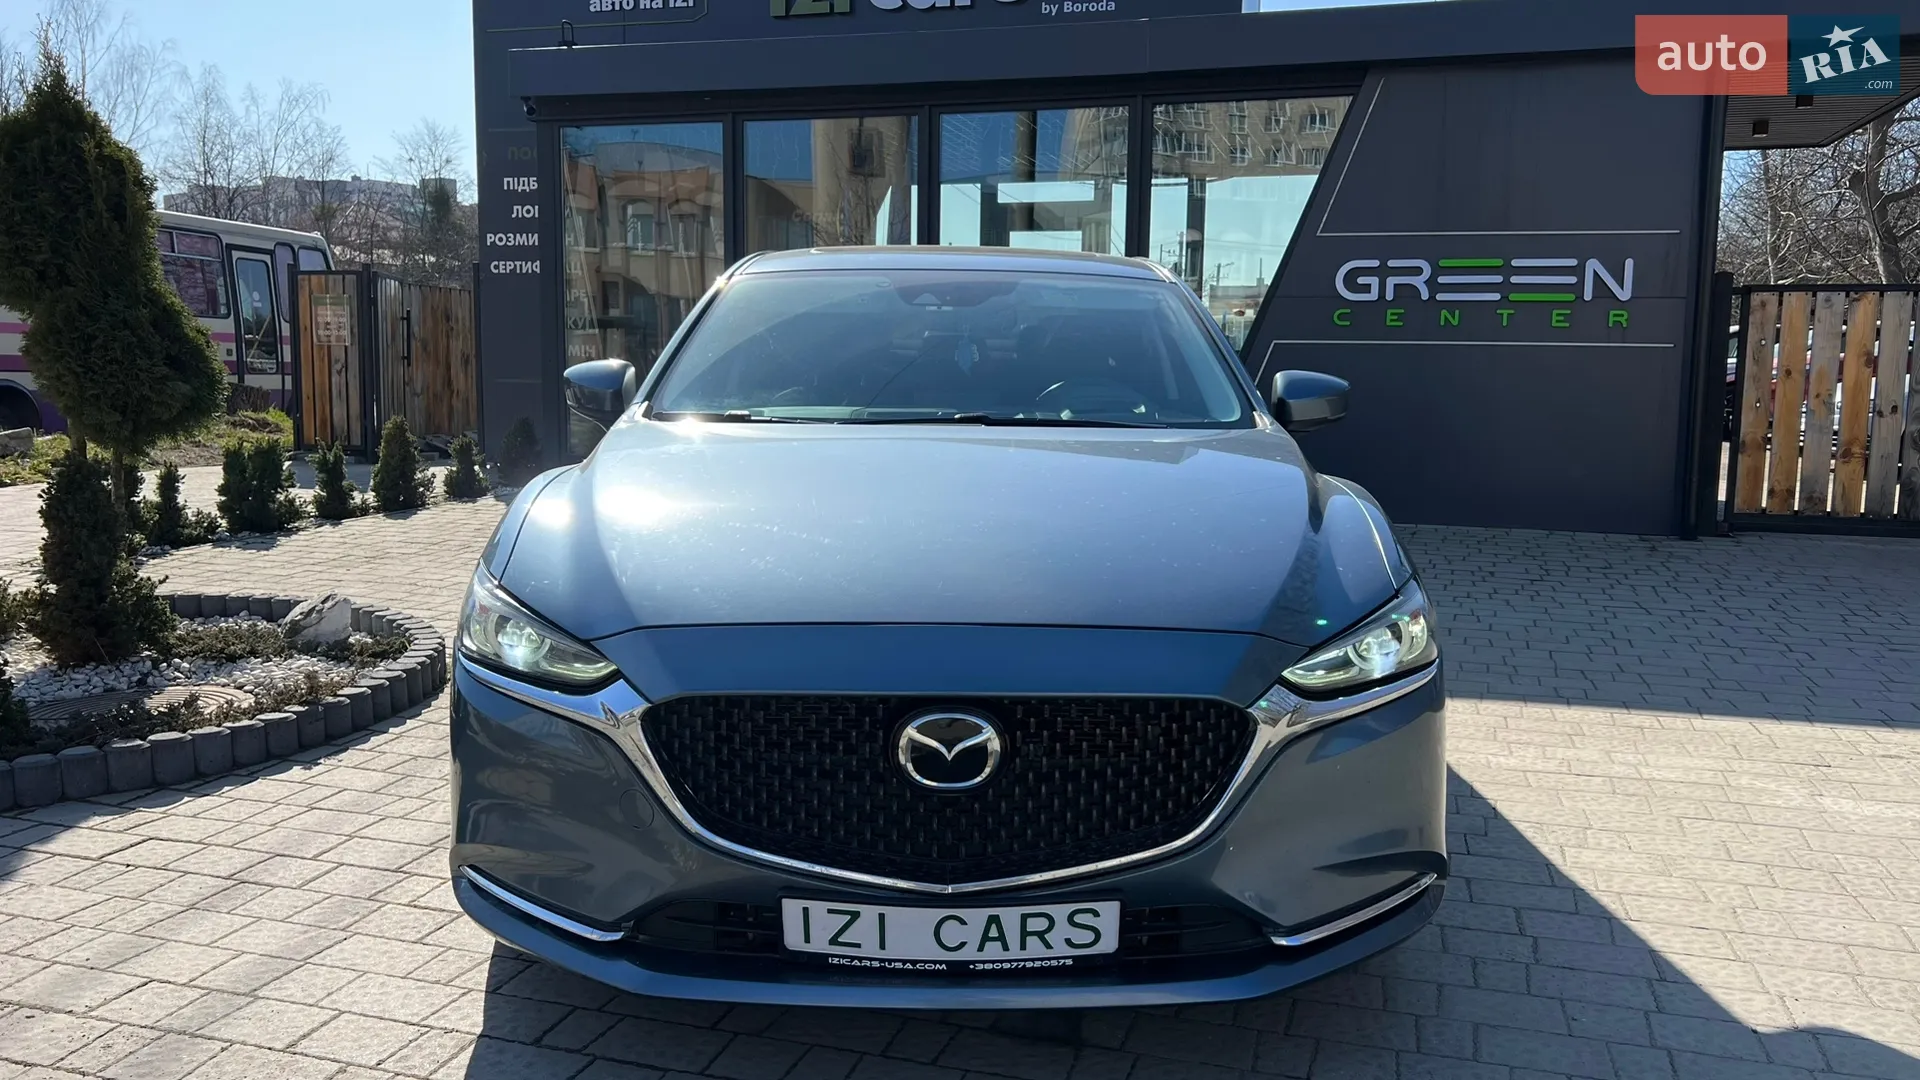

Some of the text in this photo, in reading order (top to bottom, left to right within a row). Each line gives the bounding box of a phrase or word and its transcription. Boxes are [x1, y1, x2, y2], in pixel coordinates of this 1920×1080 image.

[1041, 0, 1116, 16] by Boroda
[1335, 258, 1634, 301] GREEN
[1333, 309, 1629, 328] CENTER
[803, 907, 1102, 952] IZI CARS
[828, 957, 948, 971] IZICARS-USA.COM
